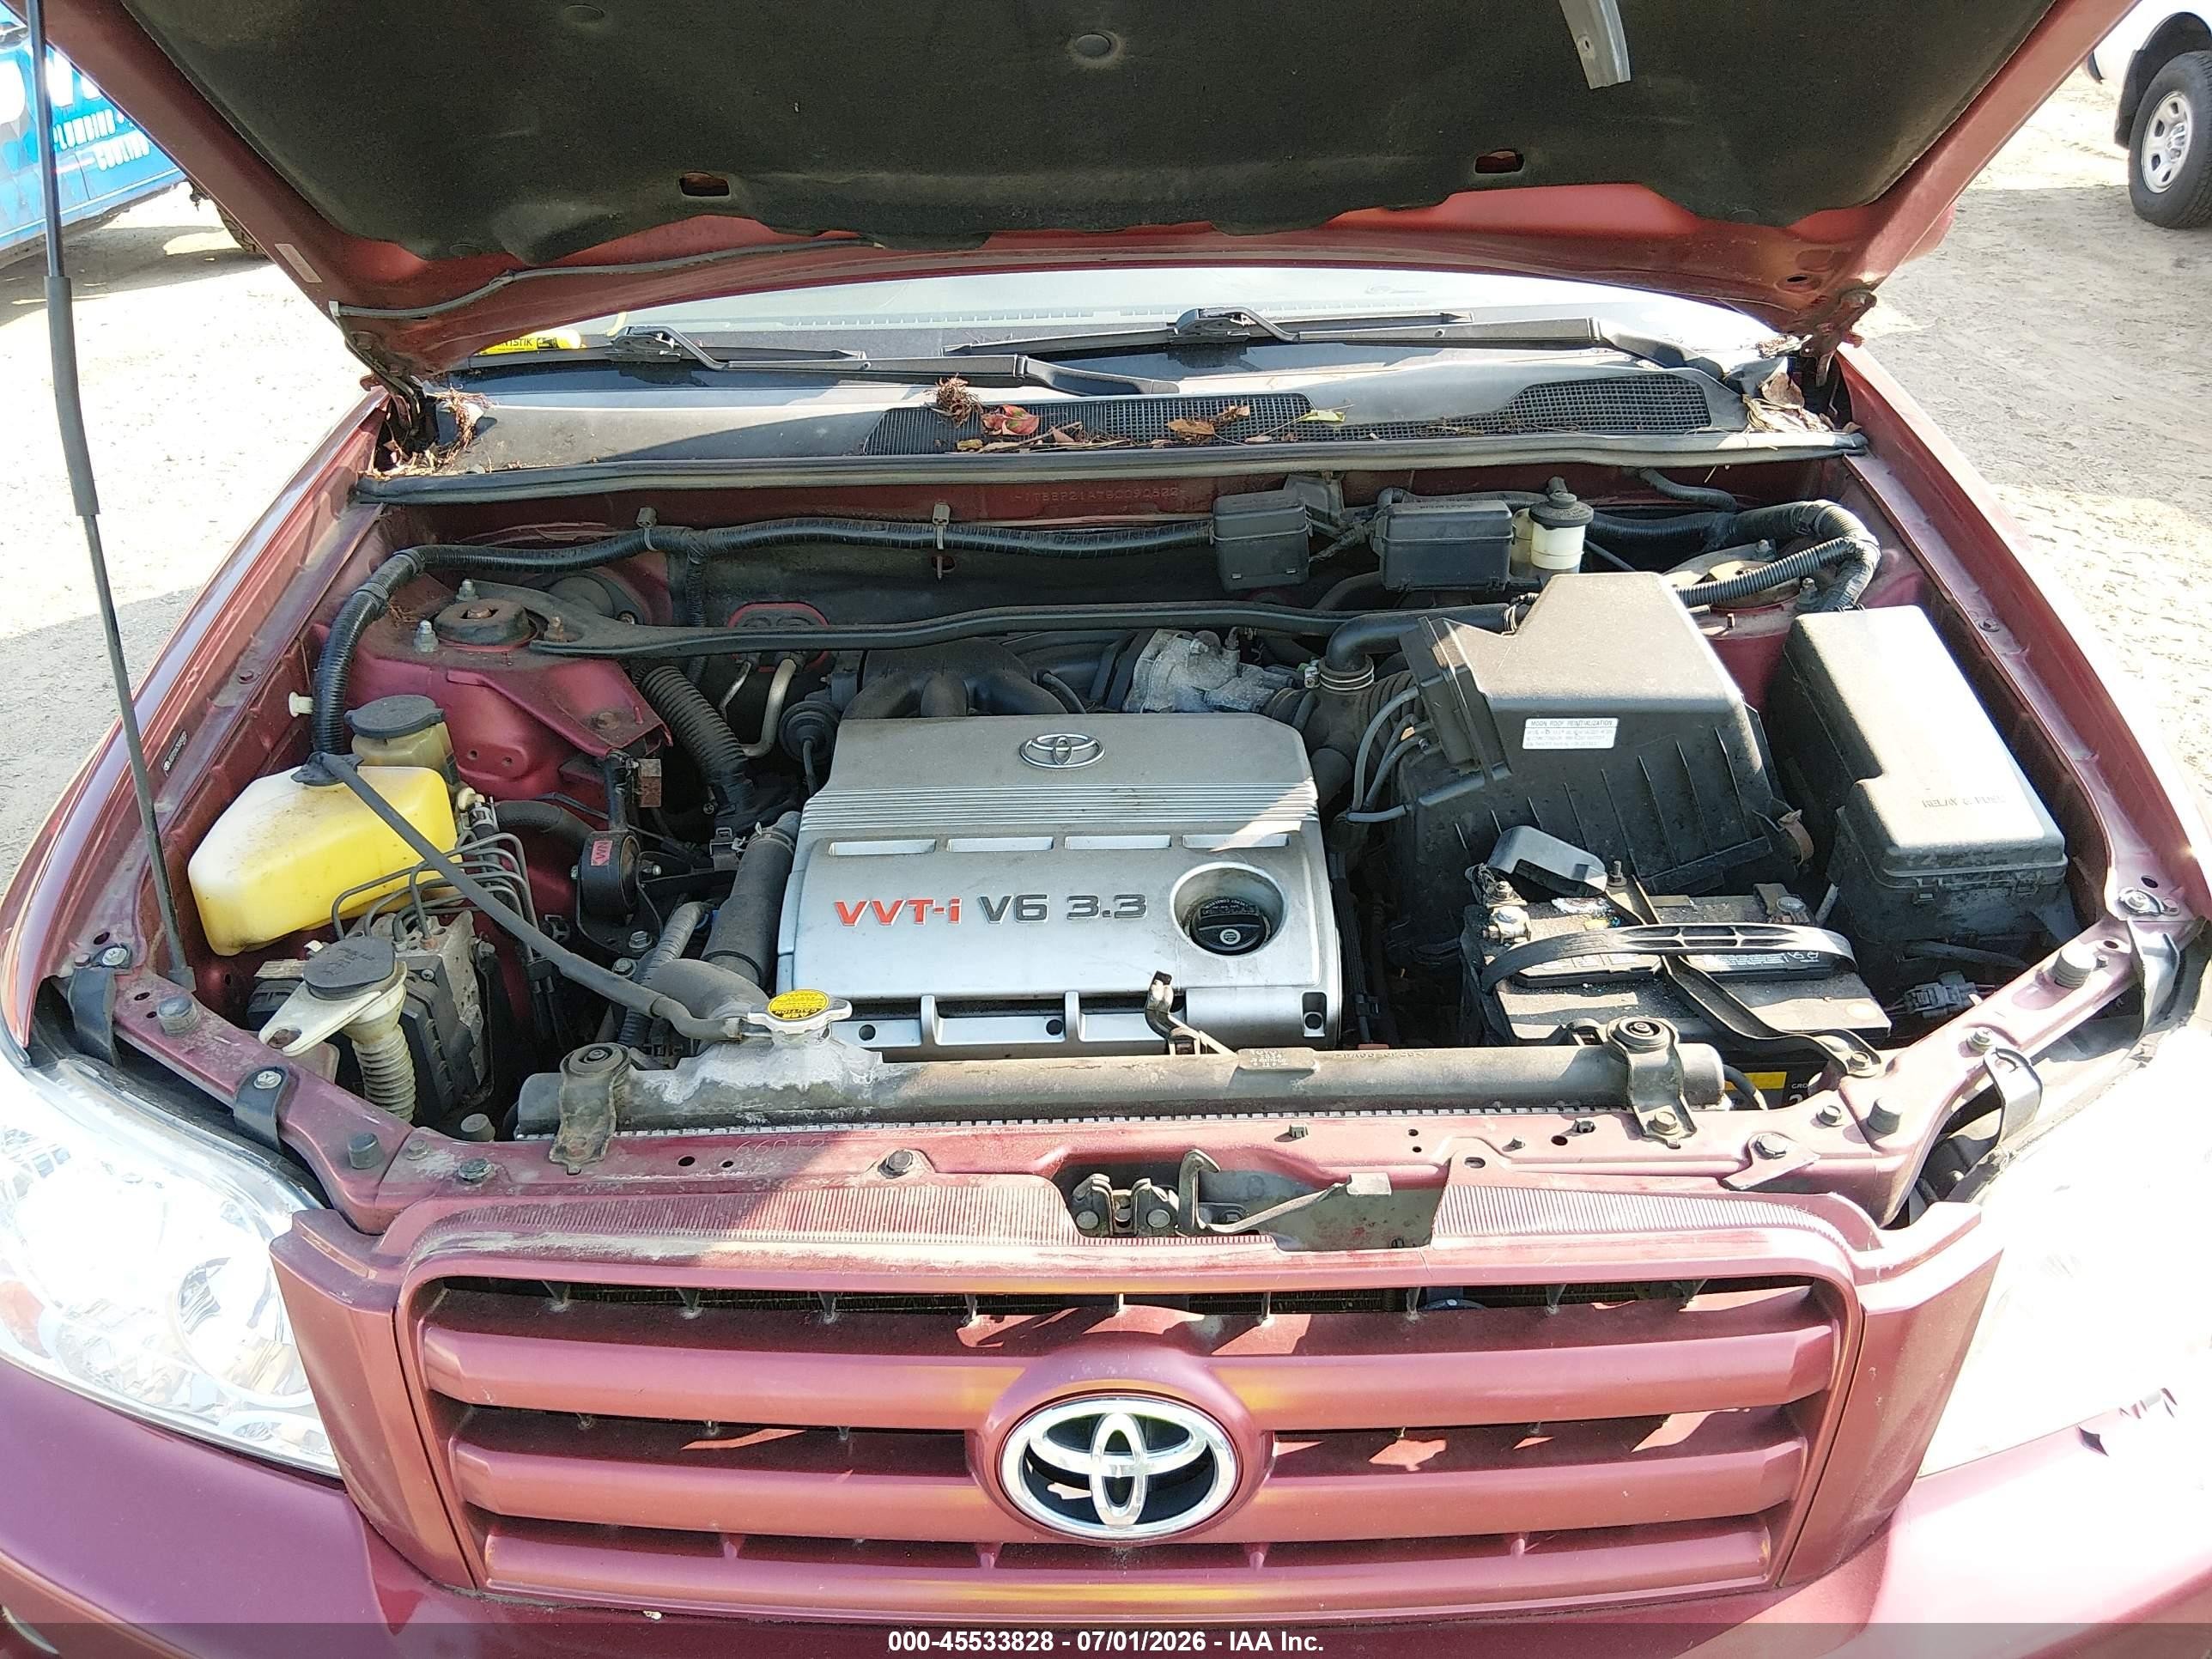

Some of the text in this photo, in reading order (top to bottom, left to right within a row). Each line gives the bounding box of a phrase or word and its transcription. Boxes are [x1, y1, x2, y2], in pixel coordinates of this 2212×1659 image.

[834, 894, 1147, 927] VVT-i V6 3.3
